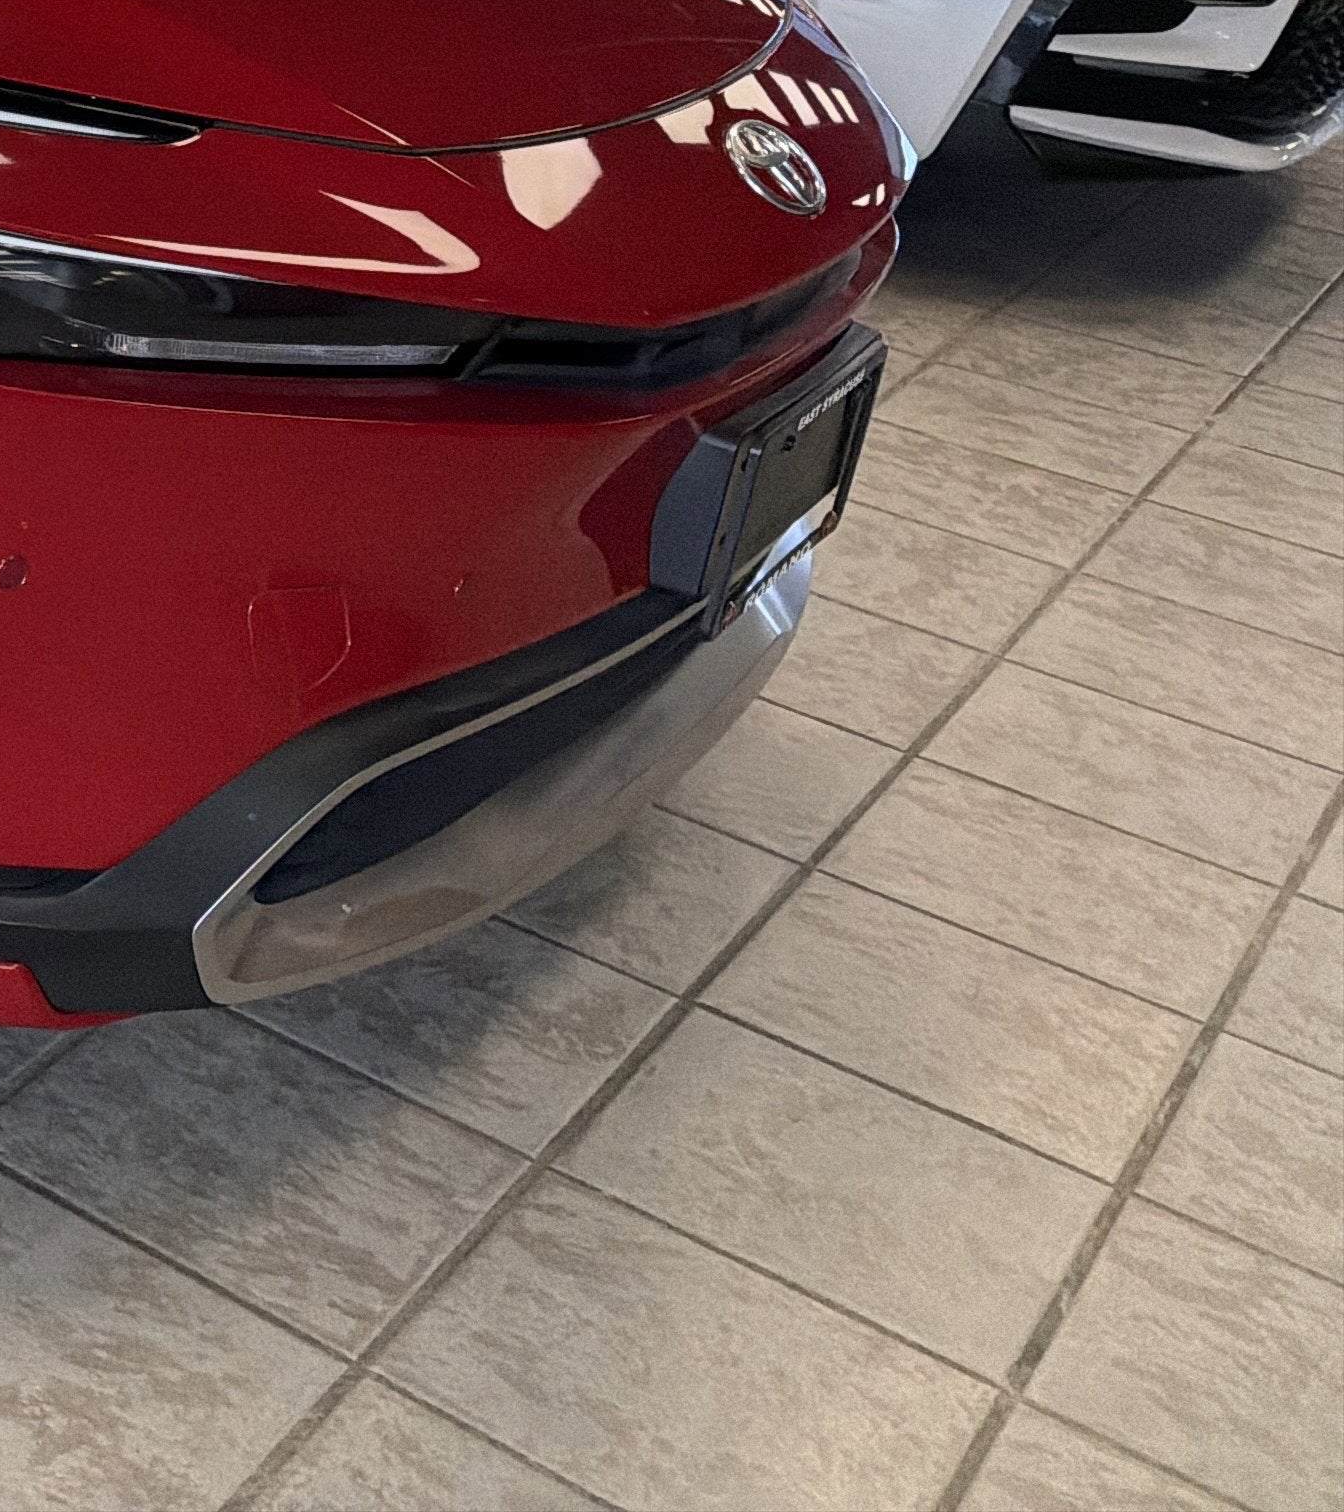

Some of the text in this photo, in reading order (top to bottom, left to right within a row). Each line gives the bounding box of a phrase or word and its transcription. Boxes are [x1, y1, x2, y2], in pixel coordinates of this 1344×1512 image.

[798, 368, 866, 432] EAST SYRACUSE
[743, 541, 812, 615] ROMANO
